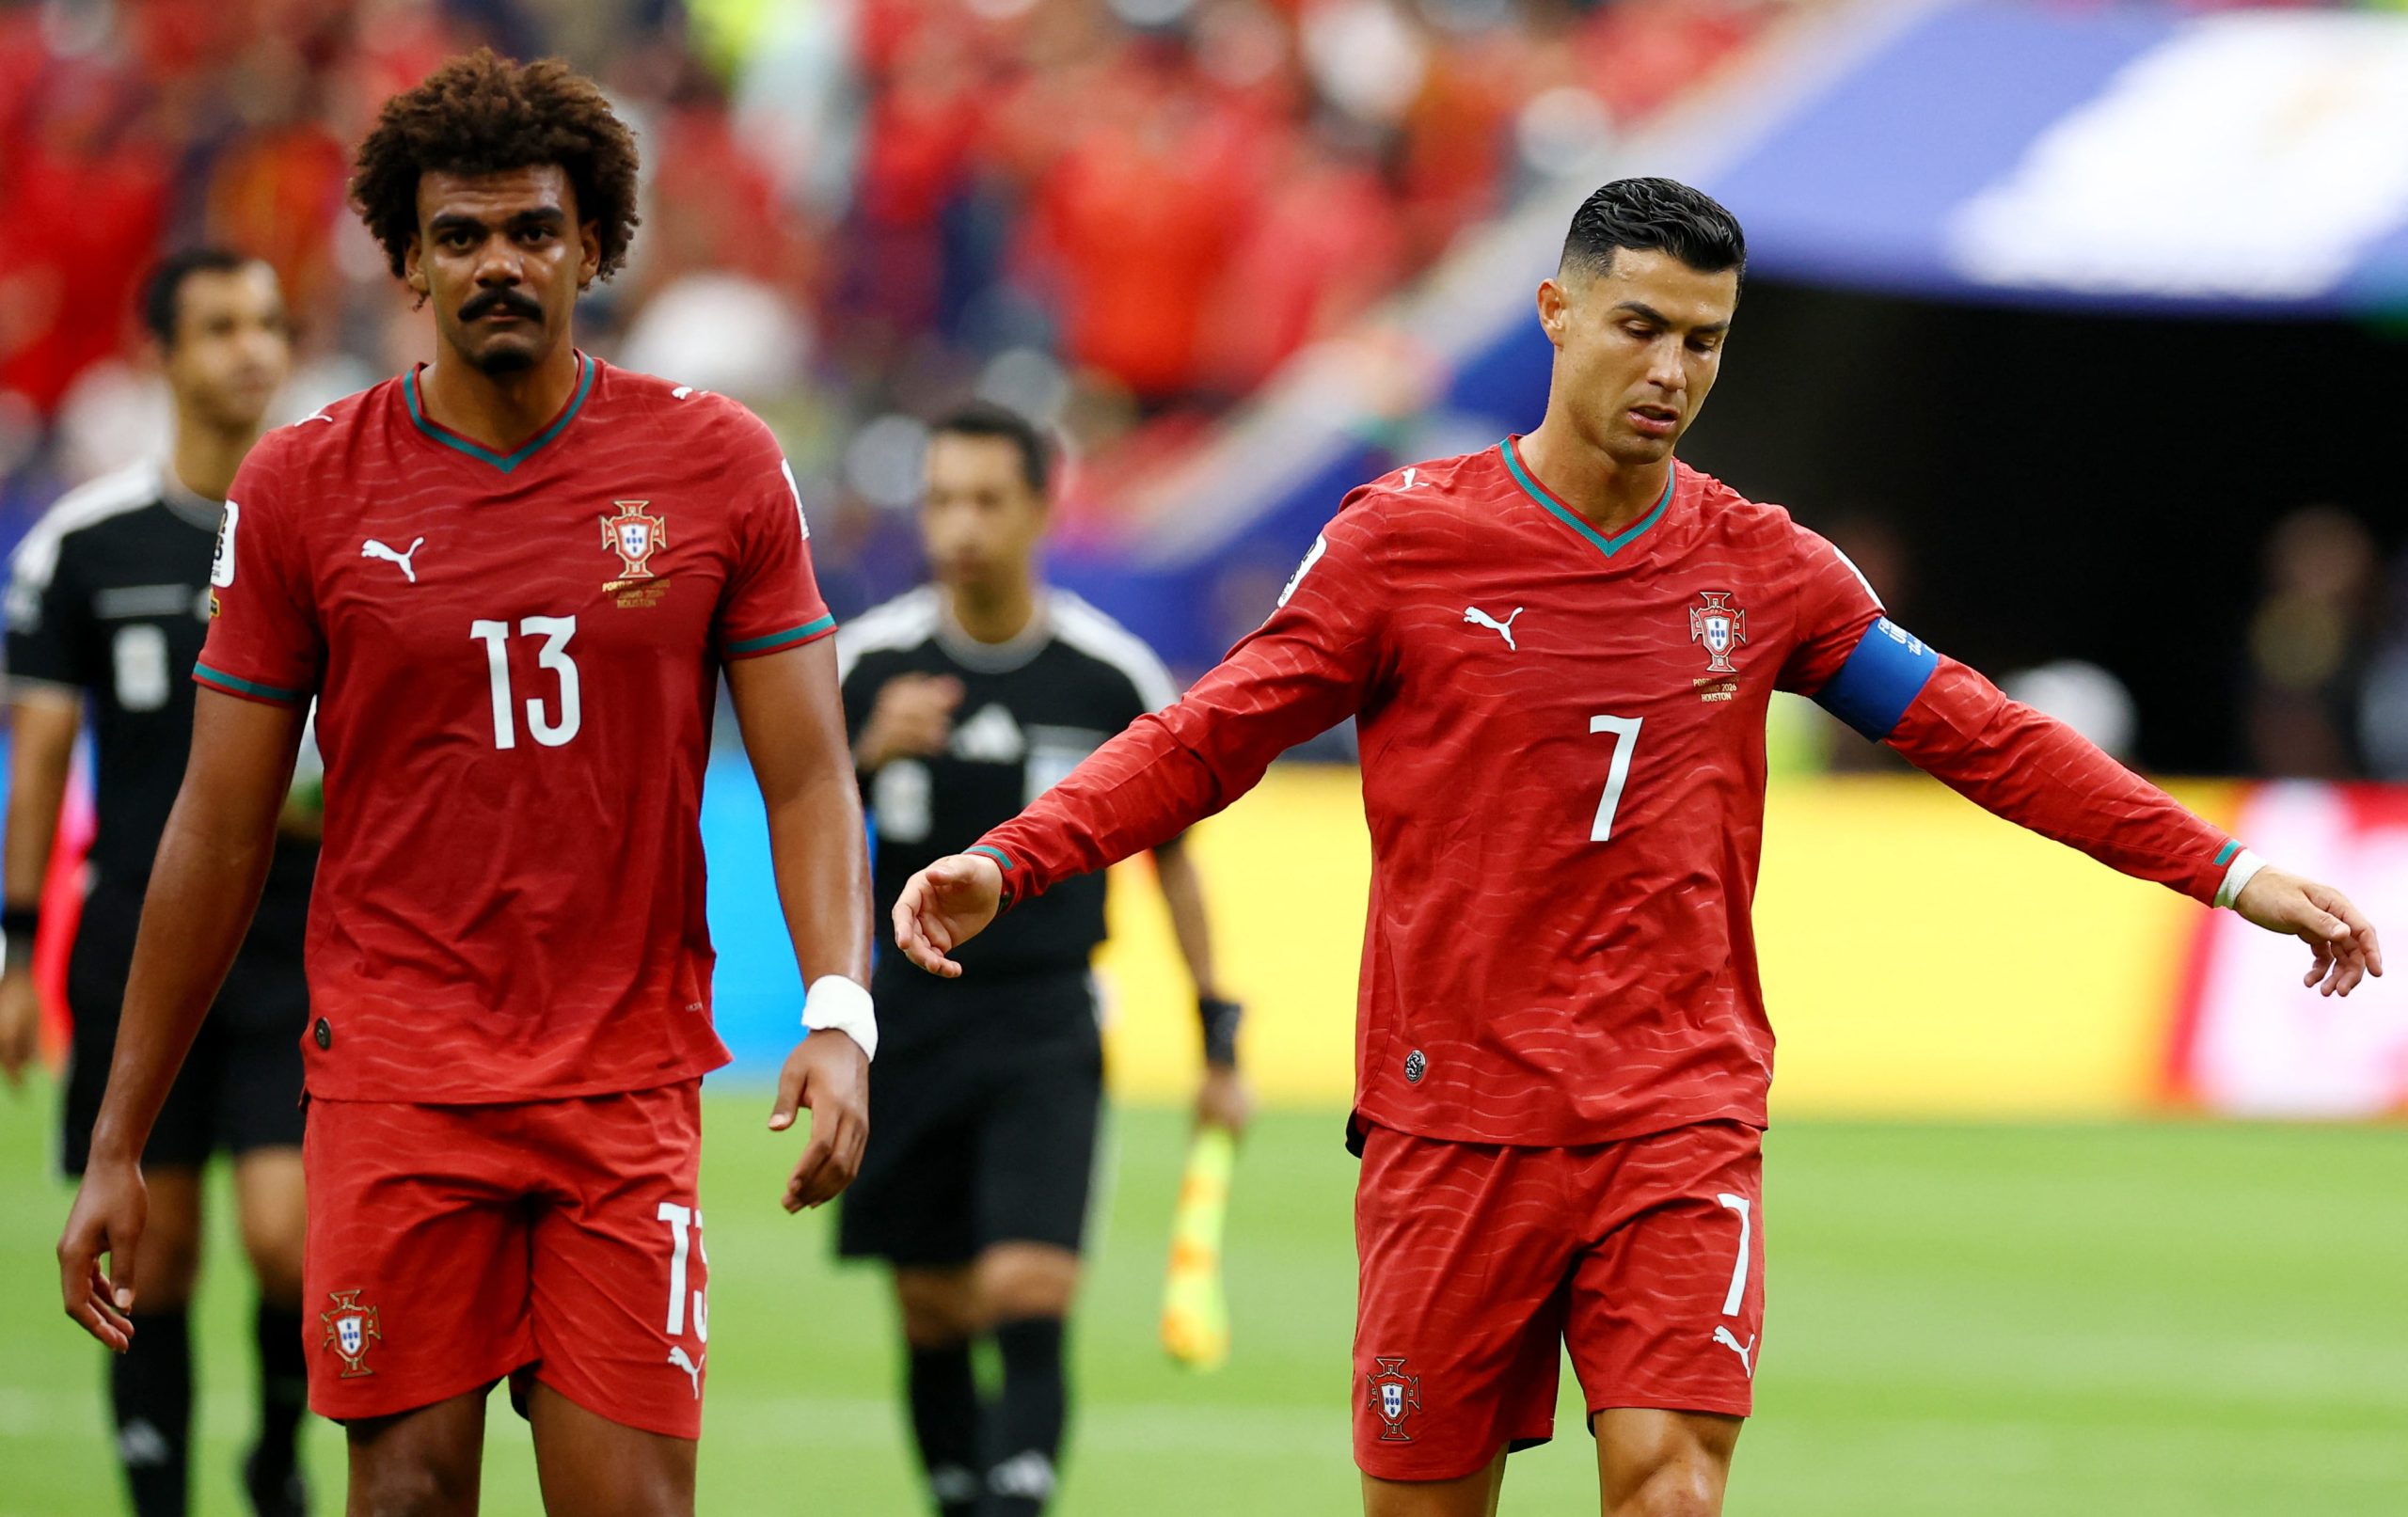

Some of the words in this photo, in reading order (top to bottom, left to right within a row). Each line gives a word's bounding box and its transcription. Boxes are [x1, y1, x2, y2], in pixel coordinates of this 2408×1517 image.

[470, 614, 581, 750] 13
[1701, 692, 1732, 703] HOUSTON
[1721, 683, 1737, 692] 2026
[1590, 715, 1644, 842] 7
[1717, 1193, 1751, 1317] 7
